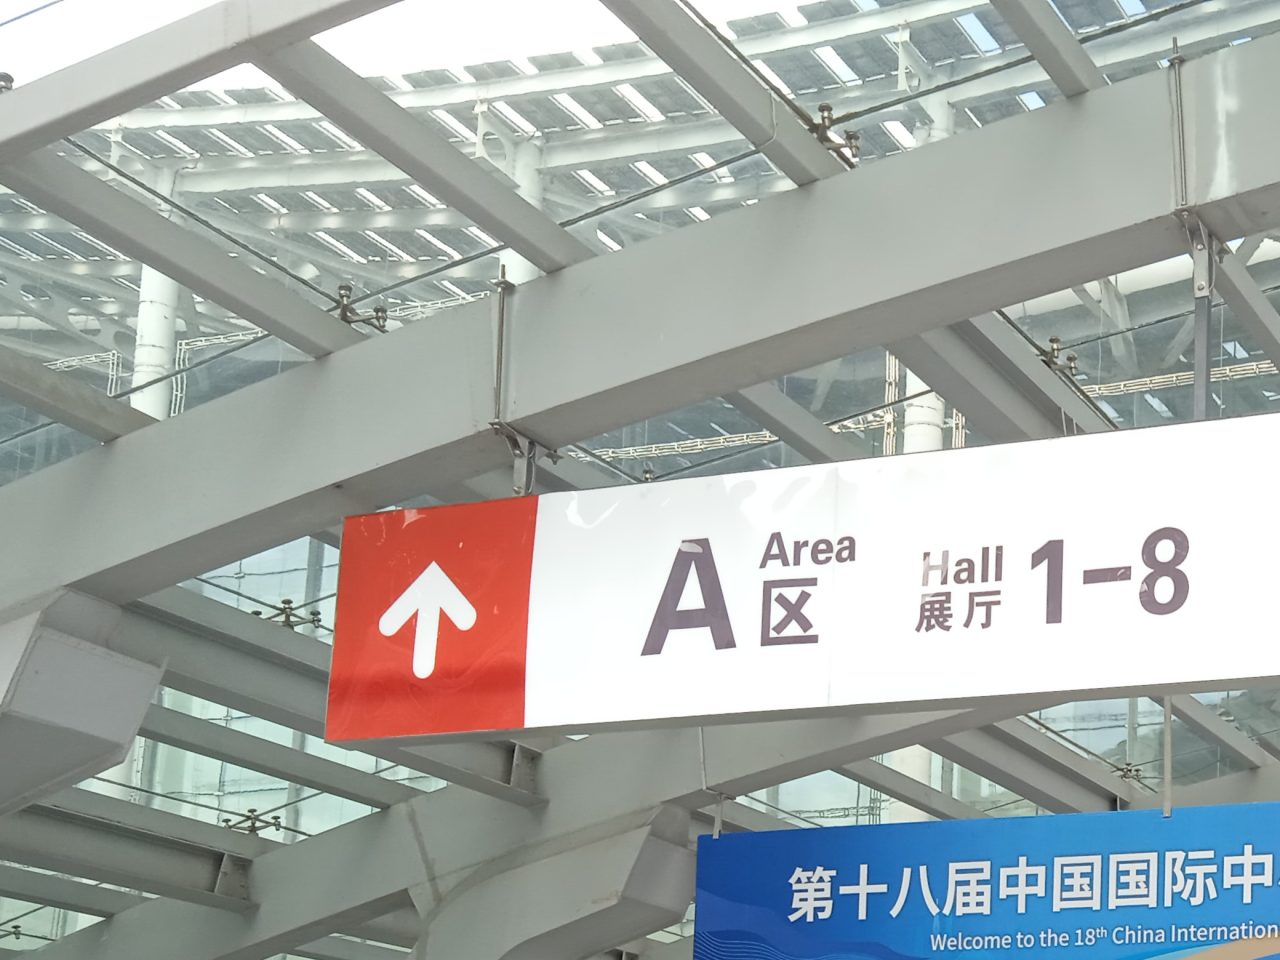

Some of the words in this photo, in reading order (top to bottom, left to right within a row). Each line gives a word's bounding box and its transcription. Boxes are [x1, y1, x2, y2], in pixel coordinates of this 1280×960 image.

[759, 530, 857, 569] Area
[921, 545, 1004, 587] Hall
[640, 537, 737, 656] A
[1030, 526, 1190, 626] 1-8
[761, 577, 820, 647] 区
[914, 590, 1004, 635] 展厅
[930, 929, 1012, 951] Welcome
[1015, 931, 1035, 949] to
[1039, 929, 1069, 948] the
[1112, 924, 1165, 944] China
